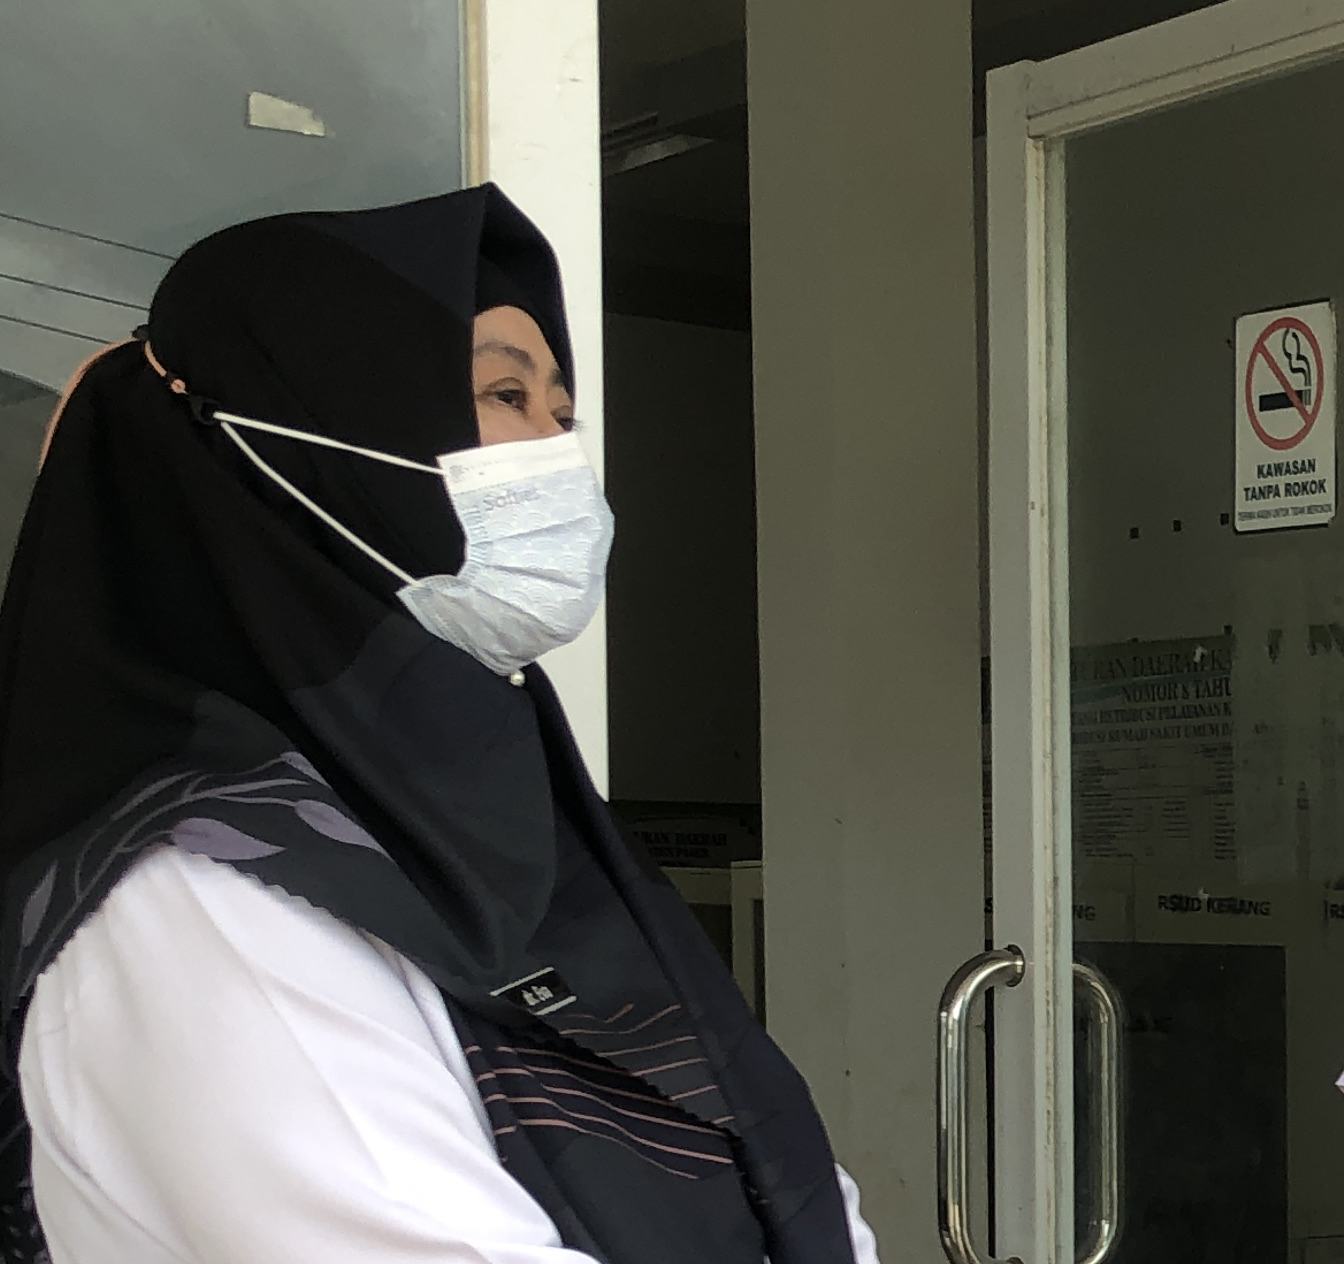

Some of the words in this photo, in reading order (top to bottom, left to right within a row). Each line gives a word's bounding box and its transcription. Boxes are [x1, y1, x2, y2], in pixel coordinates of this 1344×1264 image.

[1257, 458, 1316, 479] KAWASAN
[1243, 484, 1281, 502] TANPA
[1284, 478, 1327, 498] ROKOK
[1122, 682, 1179, 704] NOMOR
[1158, 895, 1202, 913] RSUD
